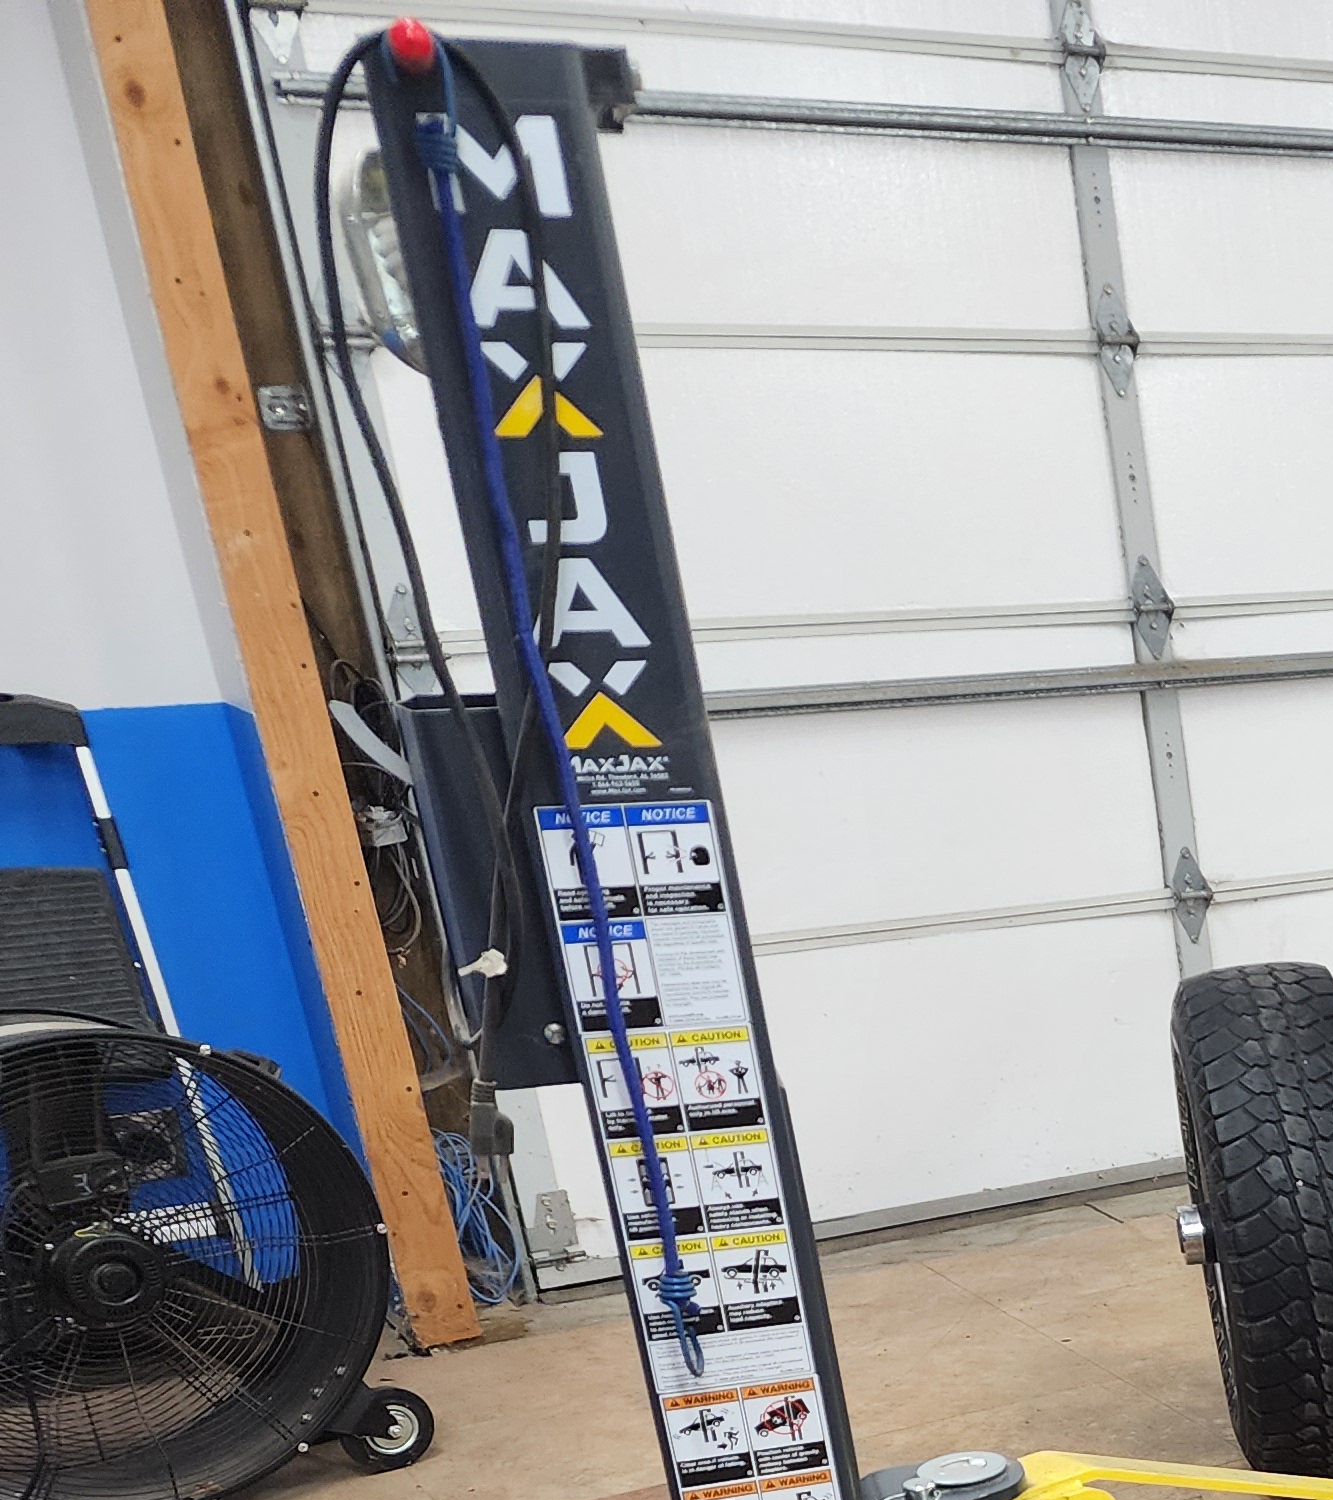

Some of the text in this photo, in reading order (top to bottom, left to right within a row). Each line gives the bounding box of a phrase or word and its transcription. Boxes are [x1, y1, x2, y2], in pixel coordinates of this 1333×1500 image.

[642, 807, 696, 821] NOTICE
[691, 1031, 741, 1042] CAUTION
[712, 1133, 761, 1144] CAUTION
[732, 1233, 781, 1245] CAUTION
[760, 1380, 810, 1394] WARNING
[683, 1391, 734, 1406] WARNING
[779, 1473, 828, 1486] WARNING
[703, 1484, 753, 1498] WARNING
